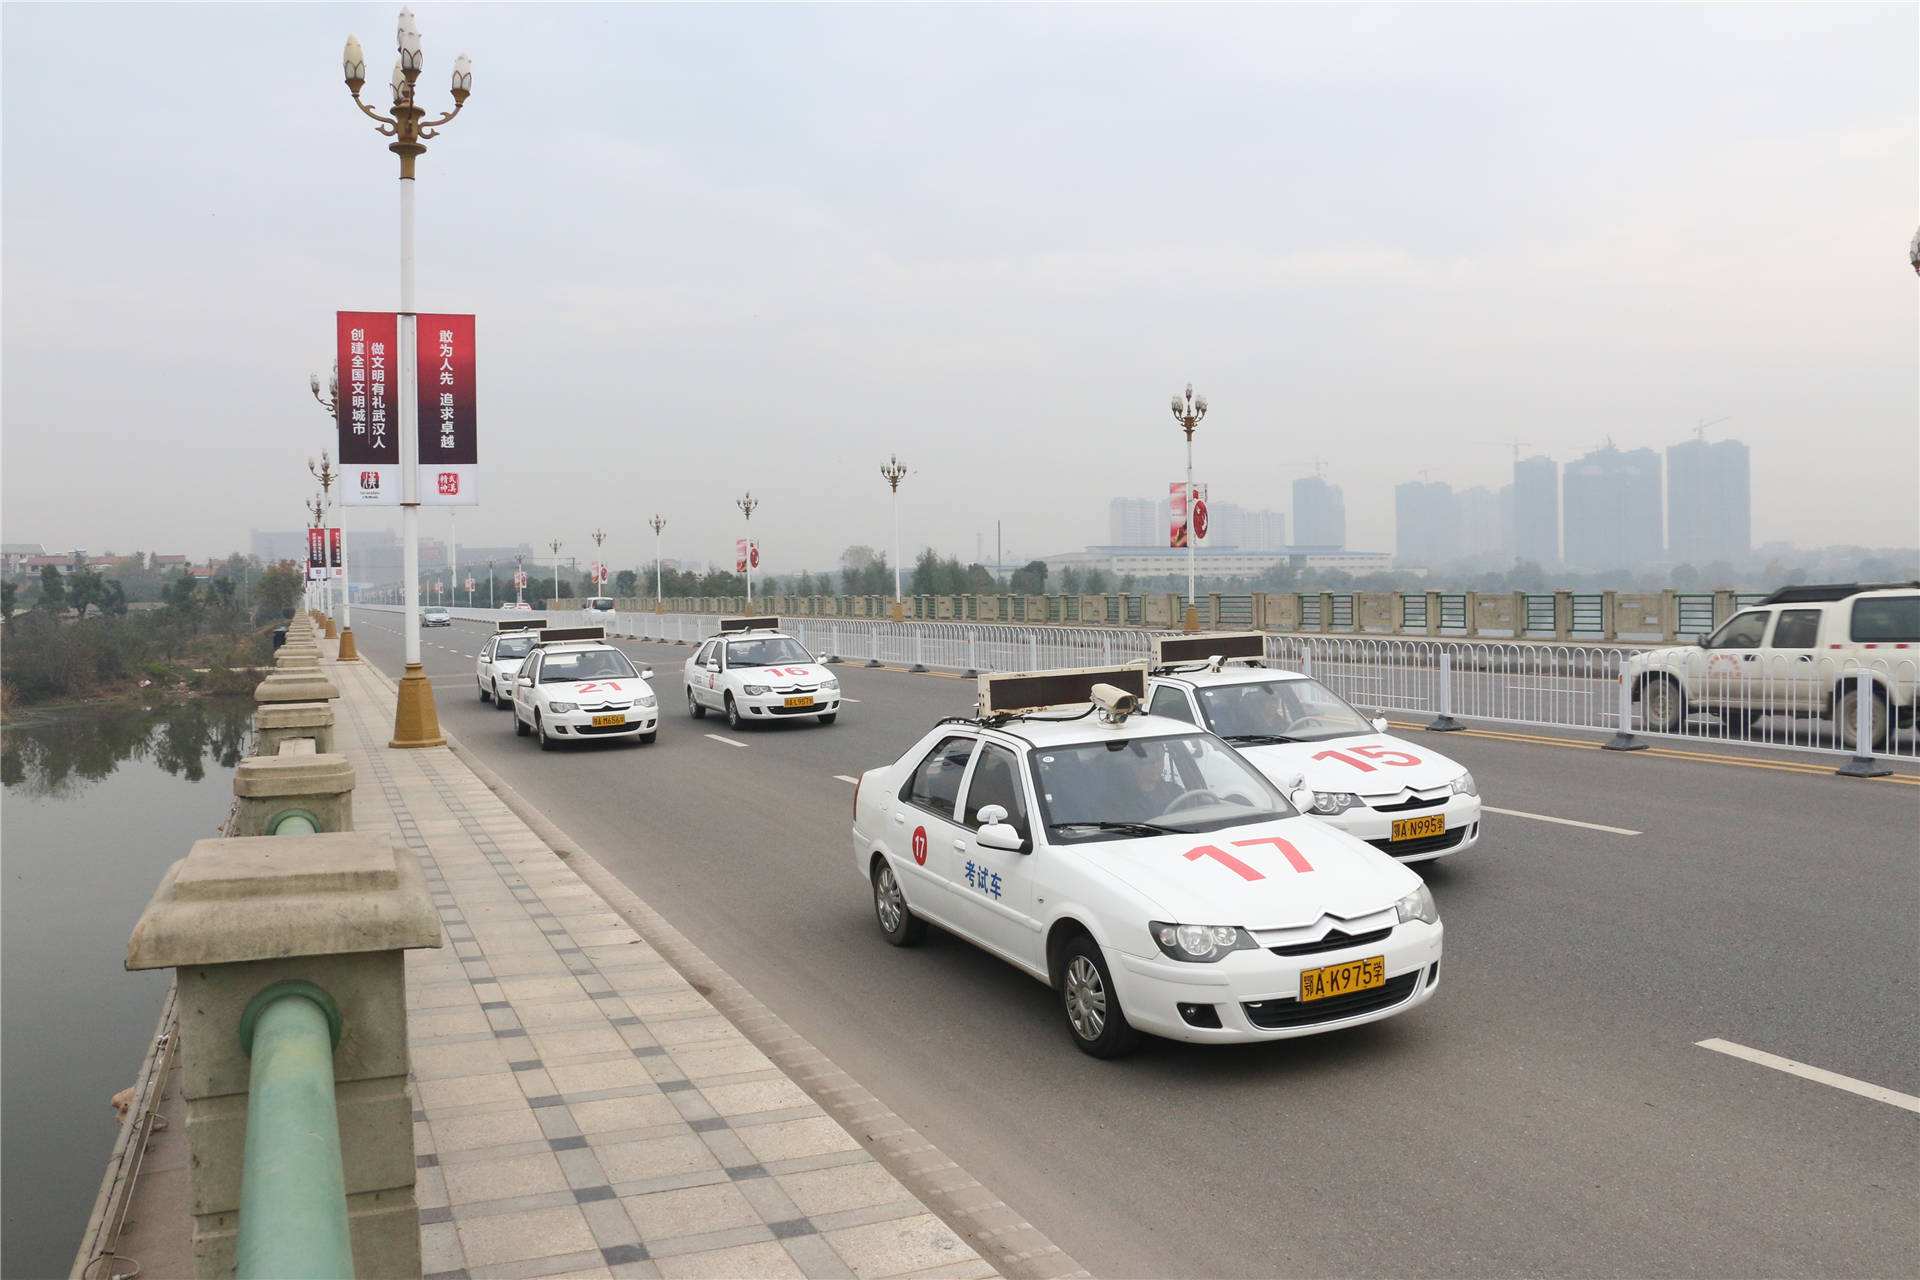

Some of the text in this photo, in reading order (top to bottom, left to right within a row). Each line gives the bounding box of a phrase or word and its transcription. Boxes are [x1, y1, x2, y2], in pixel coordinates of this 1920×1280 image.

[351, 328, 366, 435] 创建全国文明城市
[371, 342, 386, 449] 做文明有礼武汉人
[439, 330, 455, 449] 敢为人先 追求卓越
[574, 681, 622, 694] 21
[764, 666, 809, 677] 16
[1311, 745, 1422, 773] 15
[914, 835, 925, 858] 17
[1182, 836, 1315, 882] 17
[965, 860, 1002, 900] 考试车
